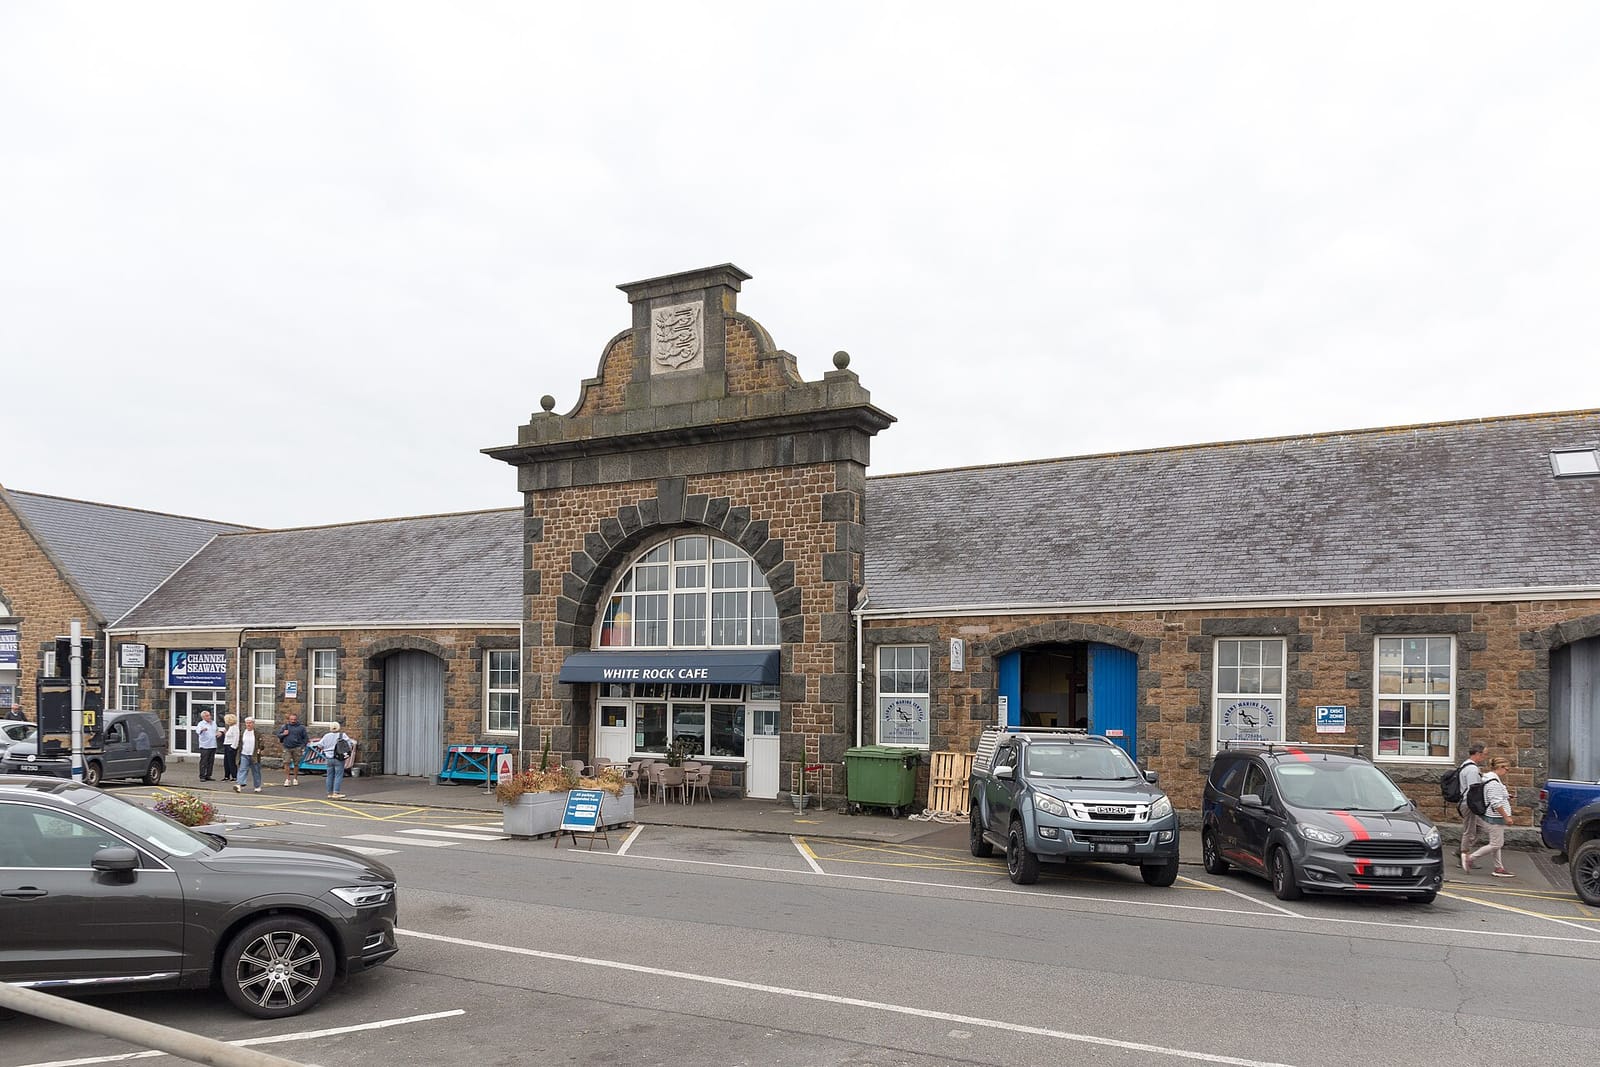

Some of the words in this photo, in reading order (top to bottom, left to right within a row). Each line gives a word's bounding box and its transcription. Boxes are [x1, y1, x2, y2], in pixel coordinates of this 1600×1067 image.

[187, 653, 226, 663] CHANNEL
[187, 663, 226, 673] SEAWAYS
[603, 668, 640, 679] WHITE
[642, 668, 675, 679] ROCK
[678, 668, 708, 679] CAFE
[1224, 704, 1237, 727] TRIDENT
[1260, 704, 1274, 728] SERVICES
[1318, 707, 1329, 720] P
